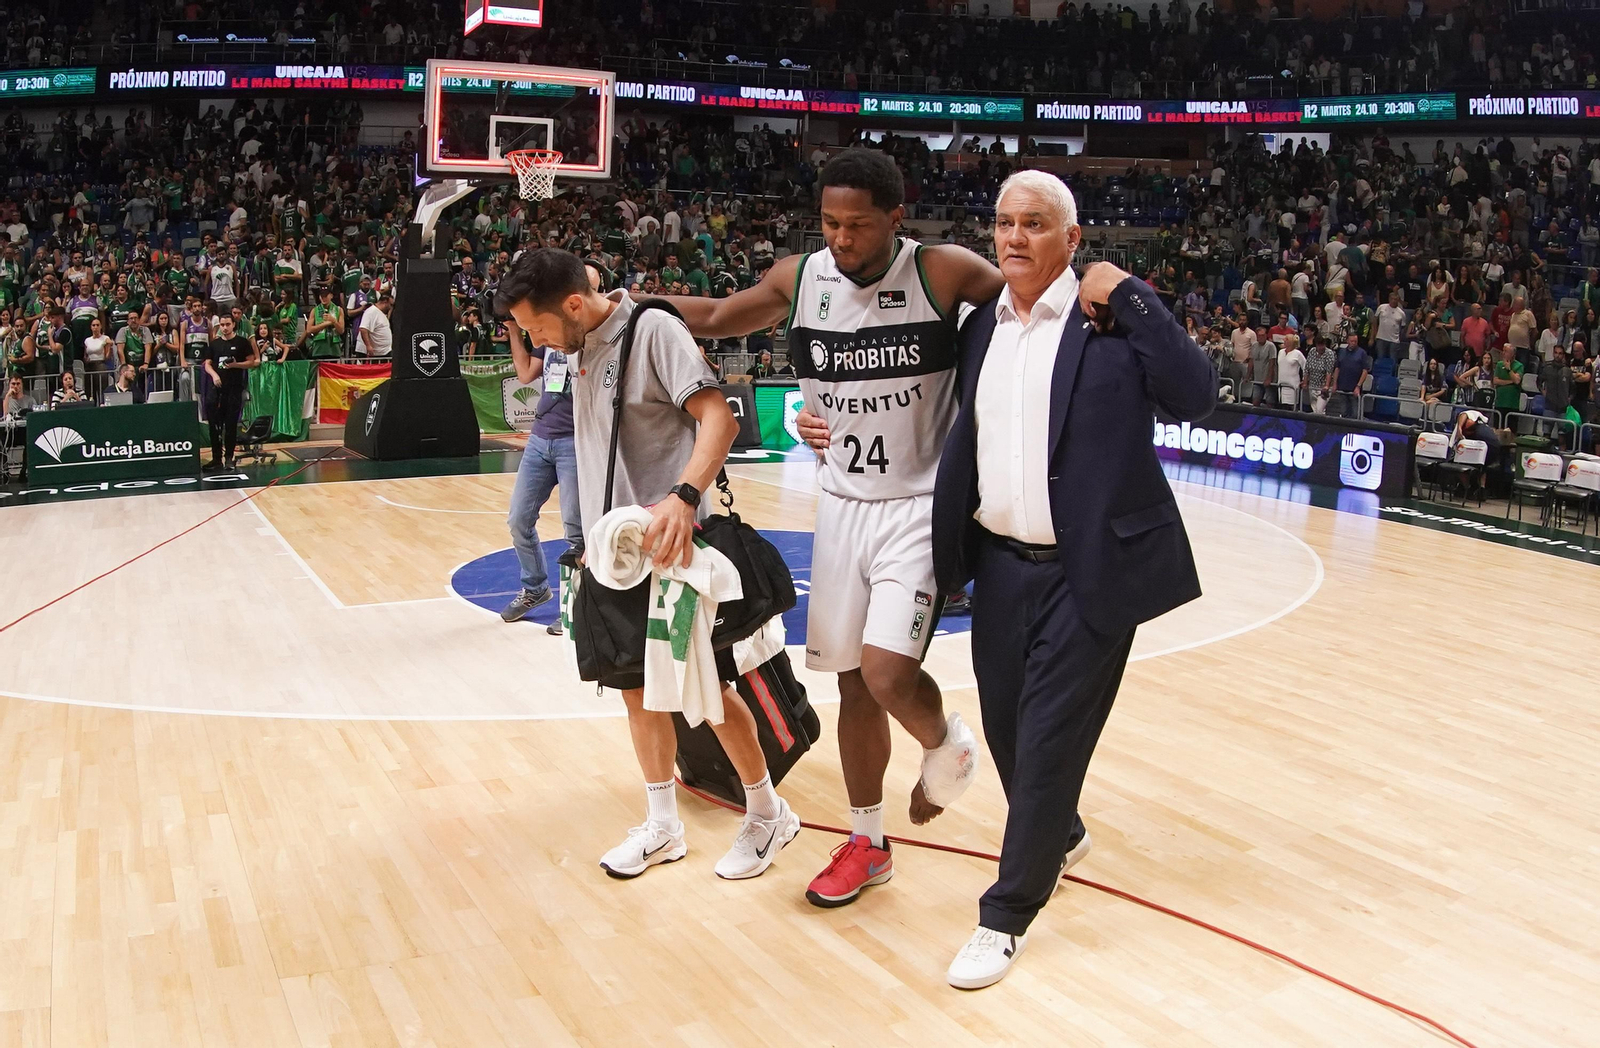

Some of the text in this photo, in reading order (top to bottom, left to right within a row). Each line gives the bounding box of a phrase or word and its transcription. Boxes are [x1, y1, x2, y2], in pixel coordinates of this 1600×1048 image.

[109, 68, 169, 89] PRÓXIMO
[172, 70, 226, 88] PARTIDO
[275, 65, 345, 78] UNICAJA
[408, 72, 424, 87] R2
[16, 77, 49, 90] 20:30h
[231, 77, 406, 89] LE MANS SARTHE BASKET
[647, 84, 696, 102] PARTIDO
[740, 86, 804, 102] UNICAJA
[701, 95, 861, 113] LE MANS SARTHE BASKET
[863, 98, 981, 114] R2 MARTES 24.10 20:30h
[1036, 101, 1091, 120] PRÓXIMO
[1094, 104, 1142, 121] PARTIDO
[1186, 101, 1248, 113] UNICAJA
[1304, 104, 1318, 119] R2
[1321, 104, 1352, 117] MARTES
[1355, 103, 1378, 116] 24.10
[1384, 101, 1415, 115] 20:30h
[1469, 94, 1524, 115] PRÓXIMO
[1528, 97, 1579, 116] PARTIDO
[1147, 112, 1303, 123] LE MANS SARTHE BASKET
[815, 274, 842, 284] SPALDING
[879, 295, 892, 303] liga
[880, 299, 906, 308] endesa
[833, 334, 920, 350] FUNDACIÓN
[194, 349, 200, 358] 9
[833, 344, 921, 372] PROBITAS
[818, 383, 924, 414] OVENTUT
[81, 439, 193, 459] Unicaja Banco
[1153, 416, 1314, 470] baloncesto
[843, 434, 890, 475] 24
[915, 595, 928, 605] acb
